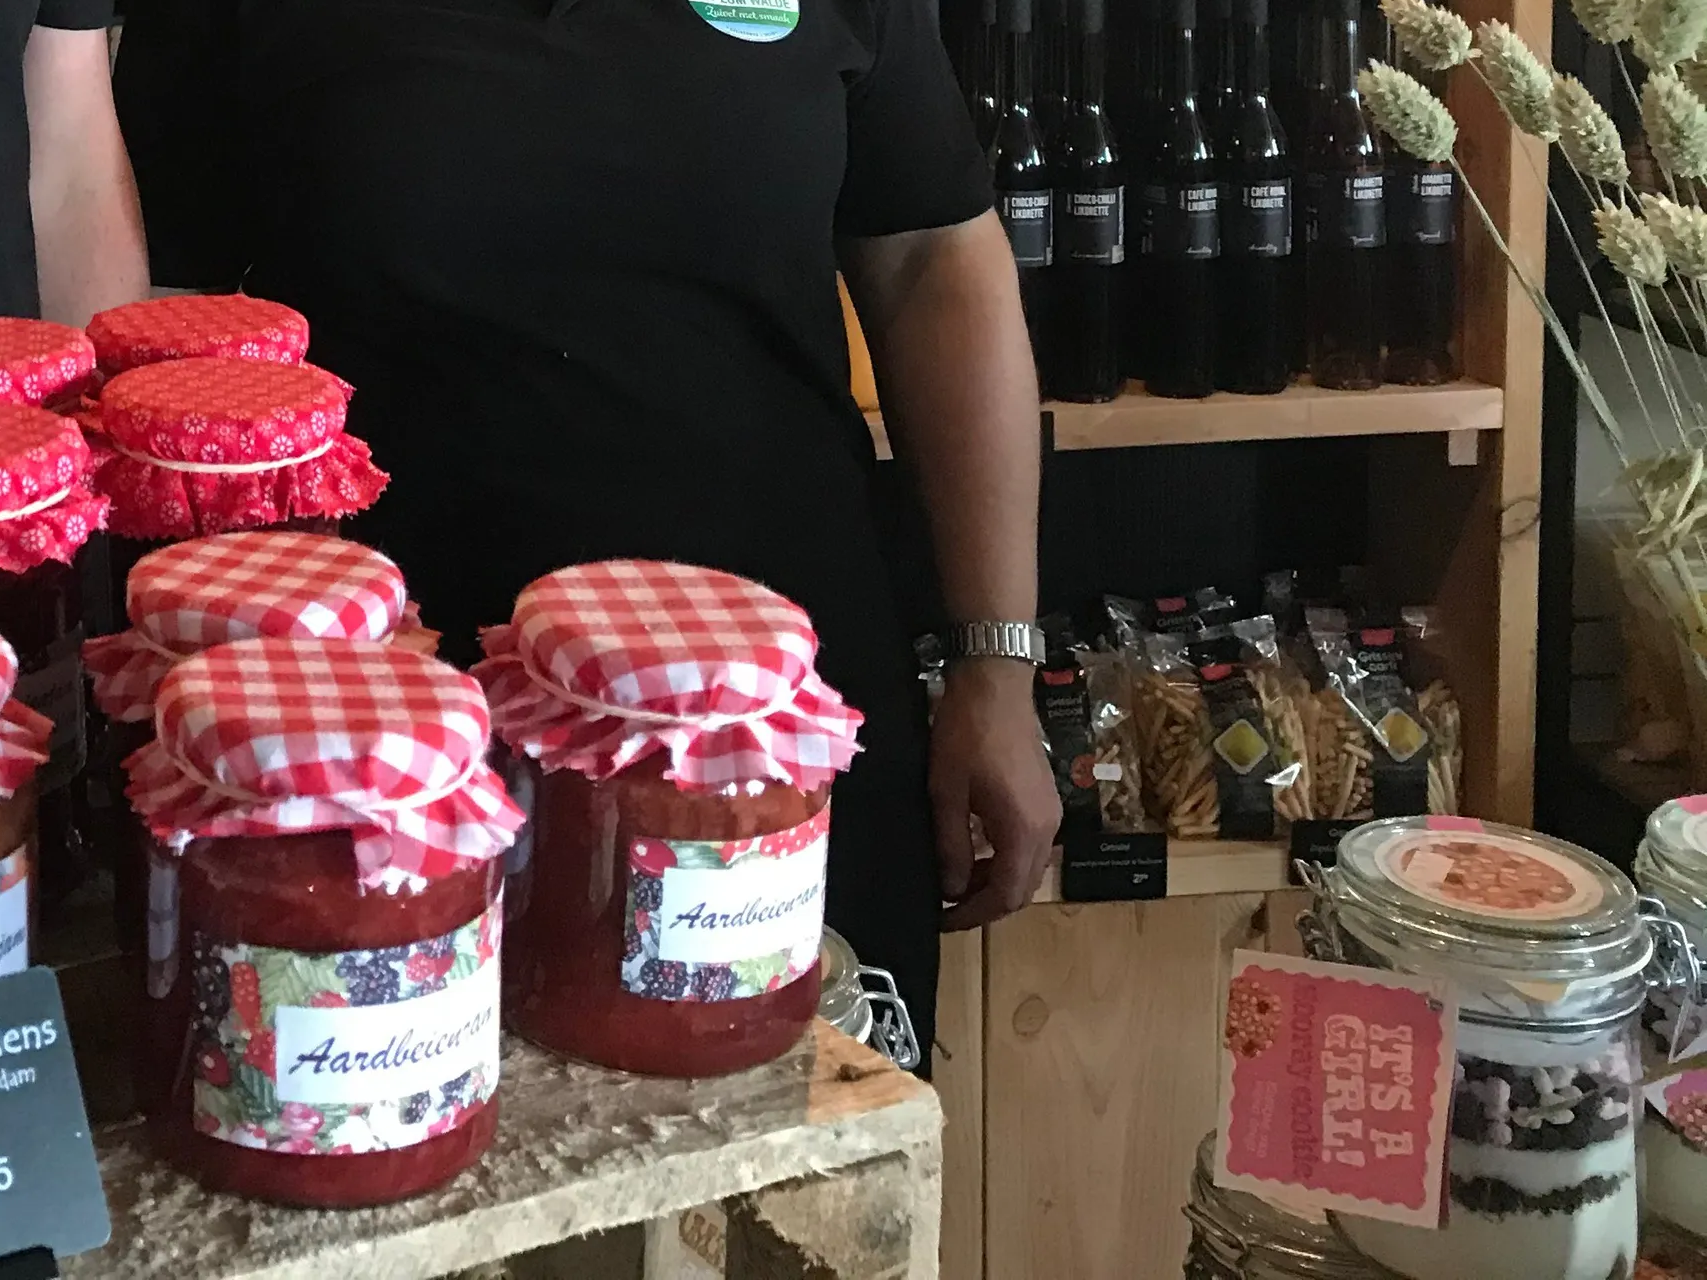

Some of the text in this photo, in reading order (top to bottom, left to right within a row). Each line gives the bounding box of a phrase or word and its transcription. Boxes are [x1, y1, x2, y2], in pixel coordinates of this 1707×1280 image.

[705, 5, 792, 24] Zuivel met smaak
[1322, 1014, 1367, 1168] GIRL!
[1369, 1023, 1415, 1159] IT'S A
